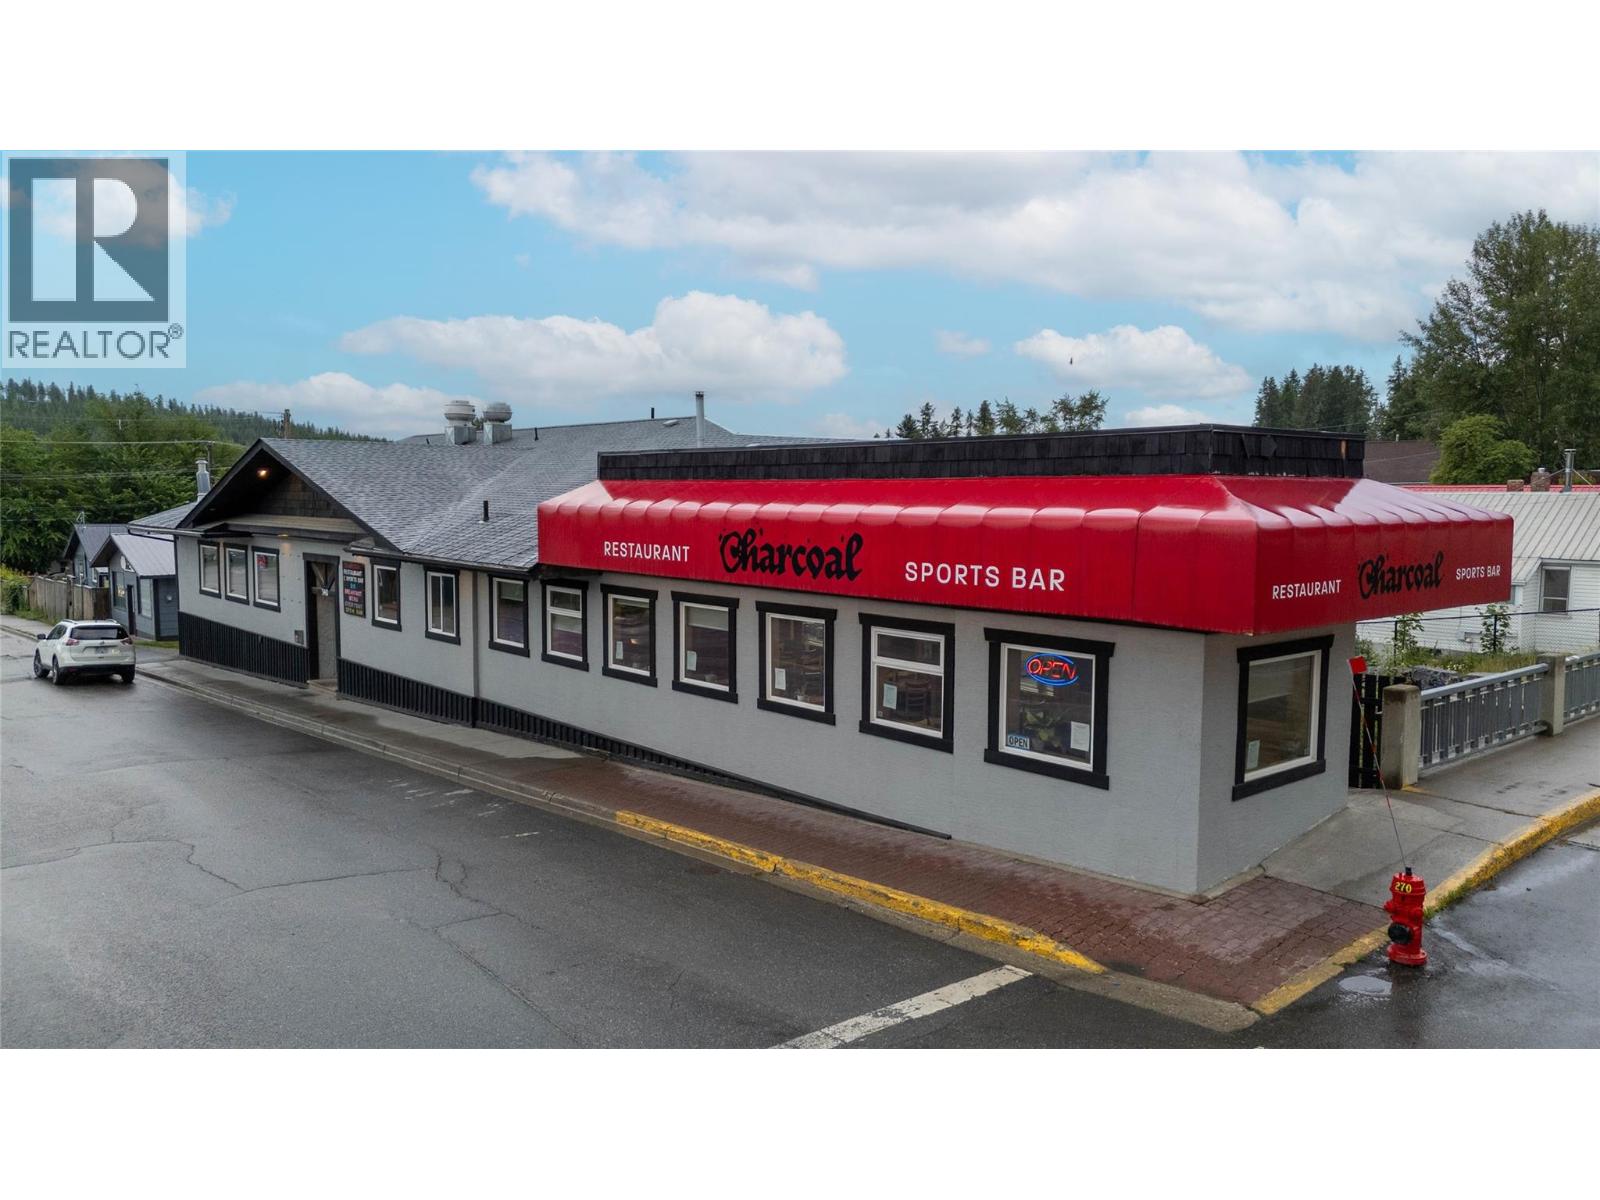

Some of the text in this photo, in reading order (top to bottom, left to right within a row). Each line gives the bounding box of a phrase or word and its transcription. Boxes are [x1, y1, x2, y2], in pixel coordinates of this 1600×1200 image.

[603, 528, 1065, 592] RESTAURANT Charcoal SPORTS BAR
[1272, 551, 1501, 600] RESTAURANT Charcoal SPORTS BAR
[1027, 658, 1078, 680] OPEN
[1008, 736, 1028, 748] OPEN
[1394, 881, 1412, 894] 270
